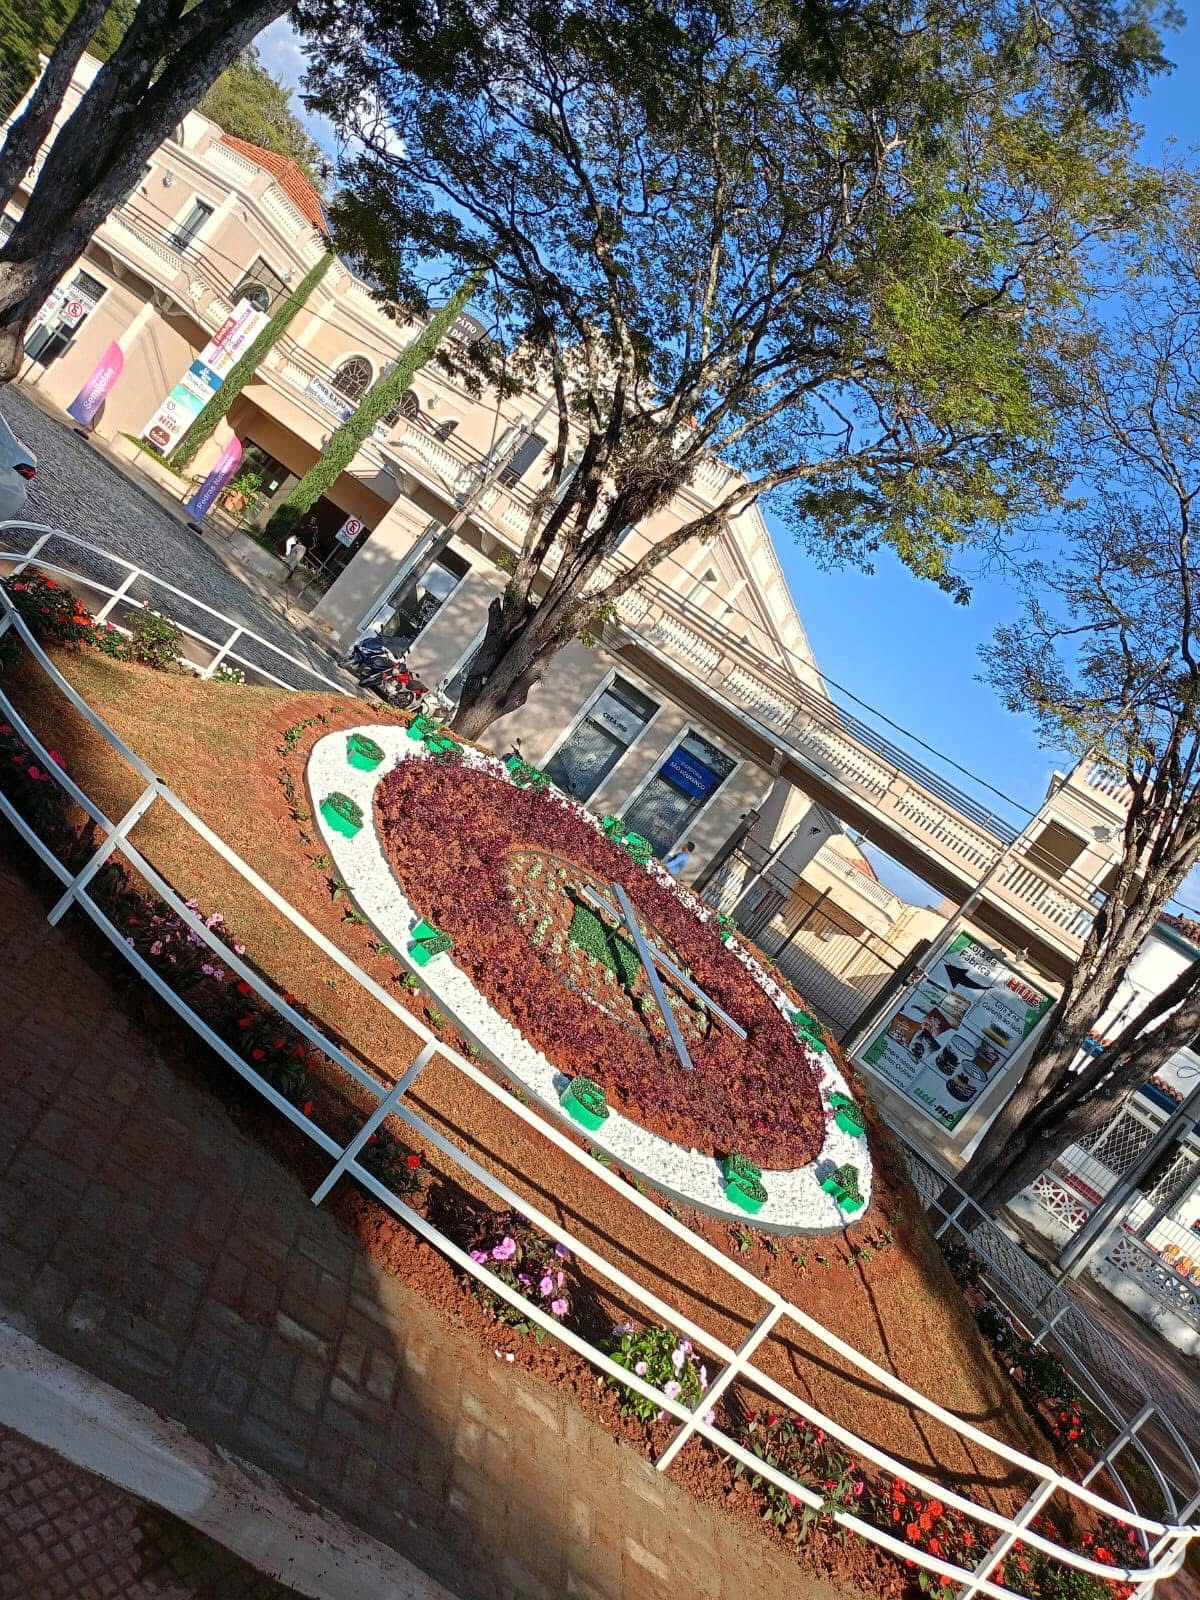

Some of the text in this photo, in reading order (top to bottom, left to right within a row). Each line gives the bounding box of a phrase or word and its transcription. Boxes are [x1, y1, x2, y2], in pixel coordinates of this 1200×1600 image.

[456, 316, 477, 334] PÁTIO
[197, 485, 216, 510] Pedras
[960, 949, 991, 977] Fábrica
[967, 941, 998, 968] Loja da
